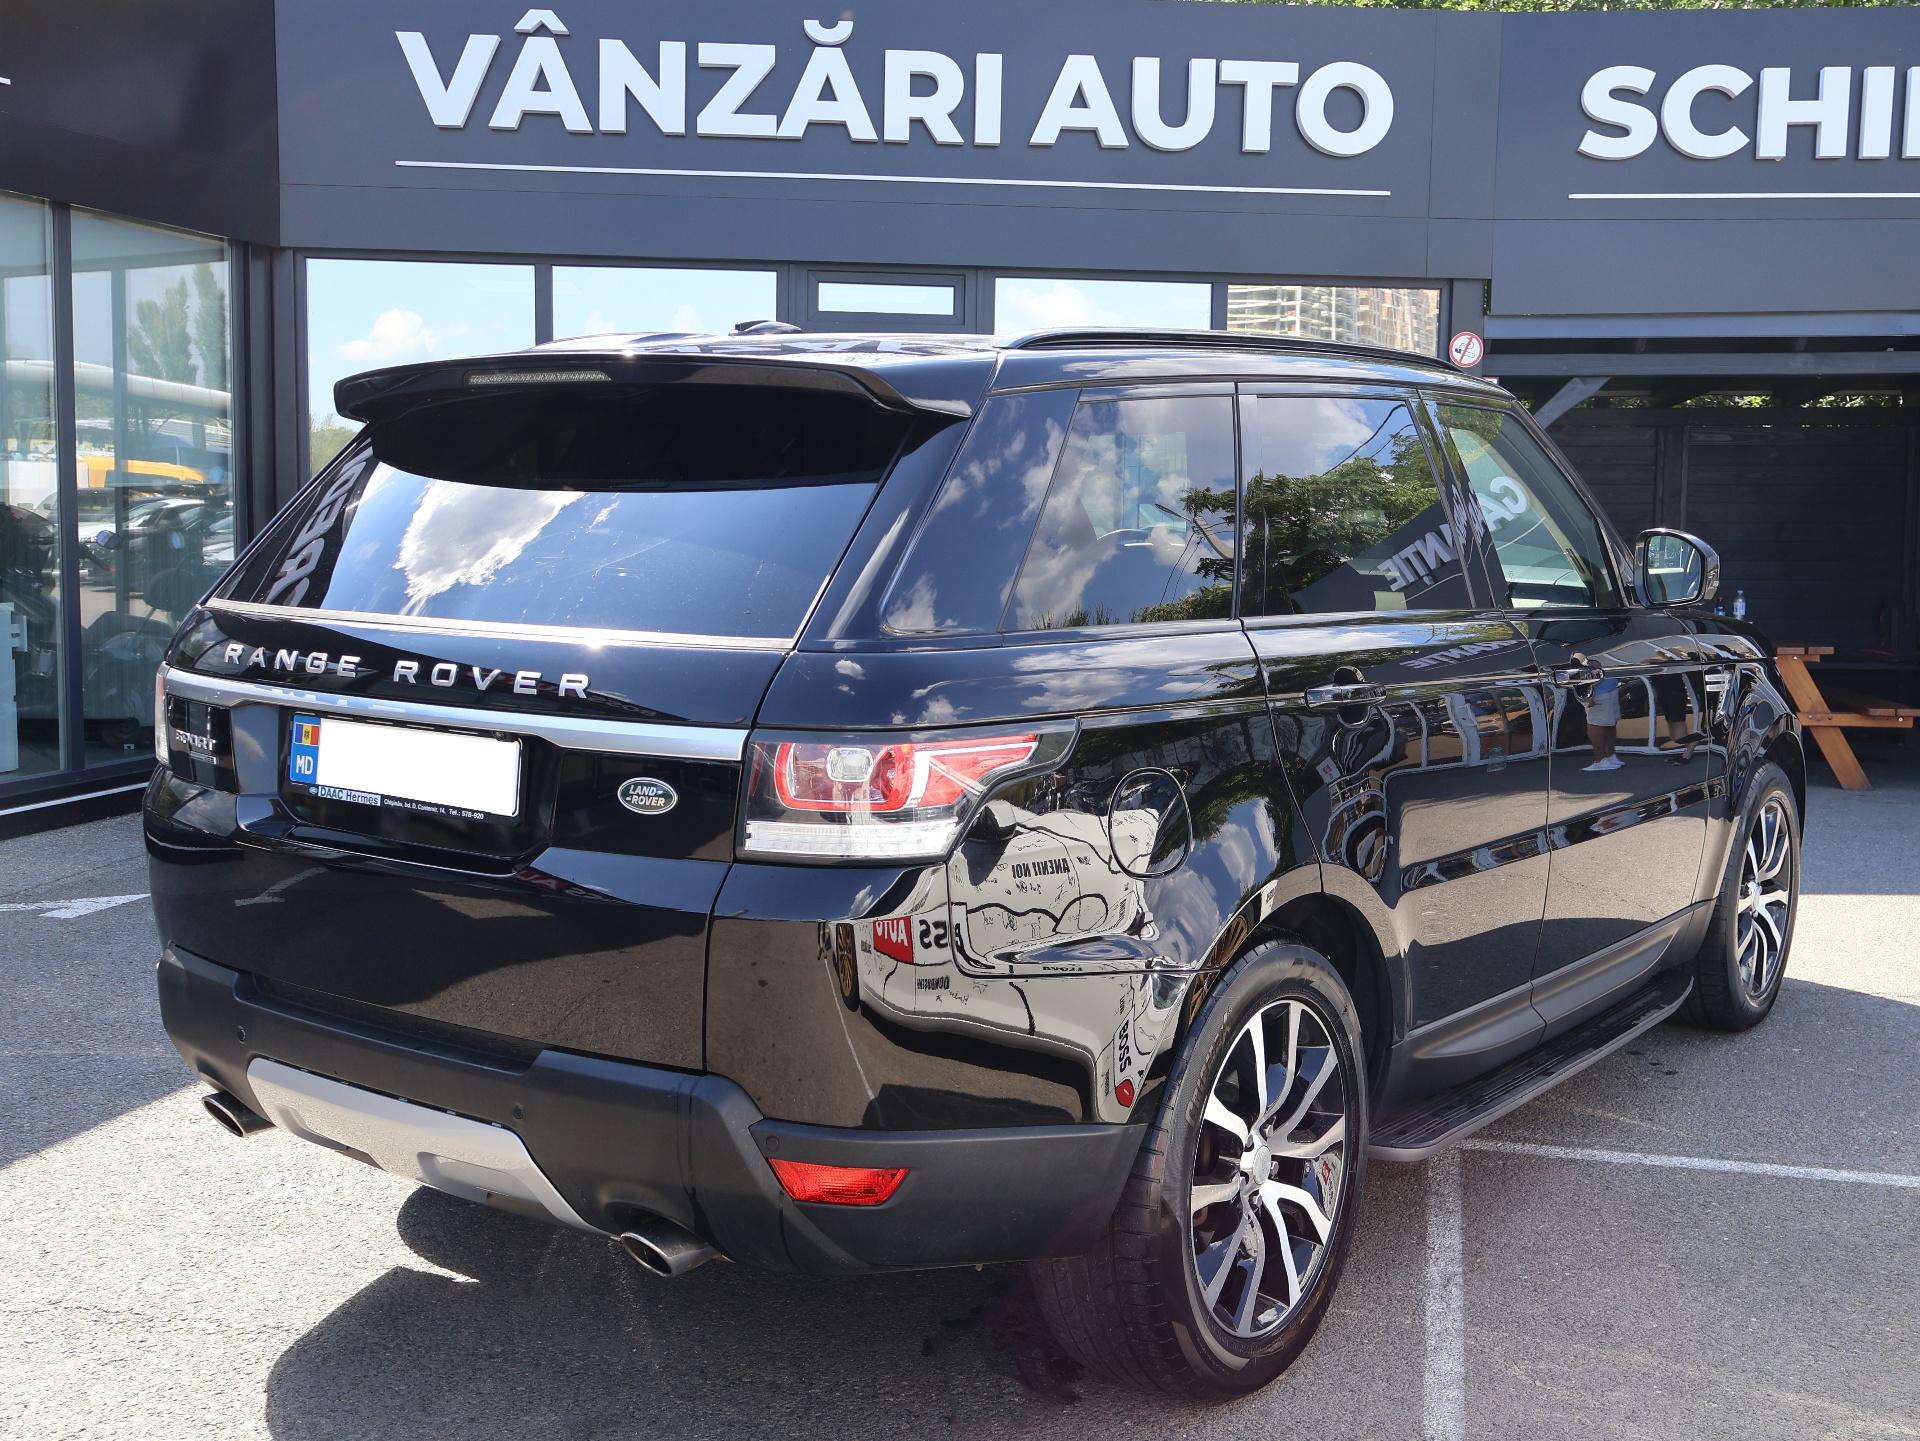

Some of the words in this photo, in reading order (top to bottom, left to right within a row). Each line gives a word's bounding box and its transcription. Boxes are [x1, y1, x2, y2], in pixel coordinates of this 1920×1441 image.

[395, 9, 1002, 147] VÂNZĂRI
[1029, 54, 1394, 157] AUTO
[1577, 64, 1920, 160] SCHI
[223, 643, 361, 678] RANGE
[393, 660, 591, 699] ROVER
[295, 754, 315, 775] MD
[319, 786, 344, 800] DAAC
[346, 790, 379, 806] Hermes
[629, 785, 657, 796] LAND
[631, 795, 666, 807] ROVER
